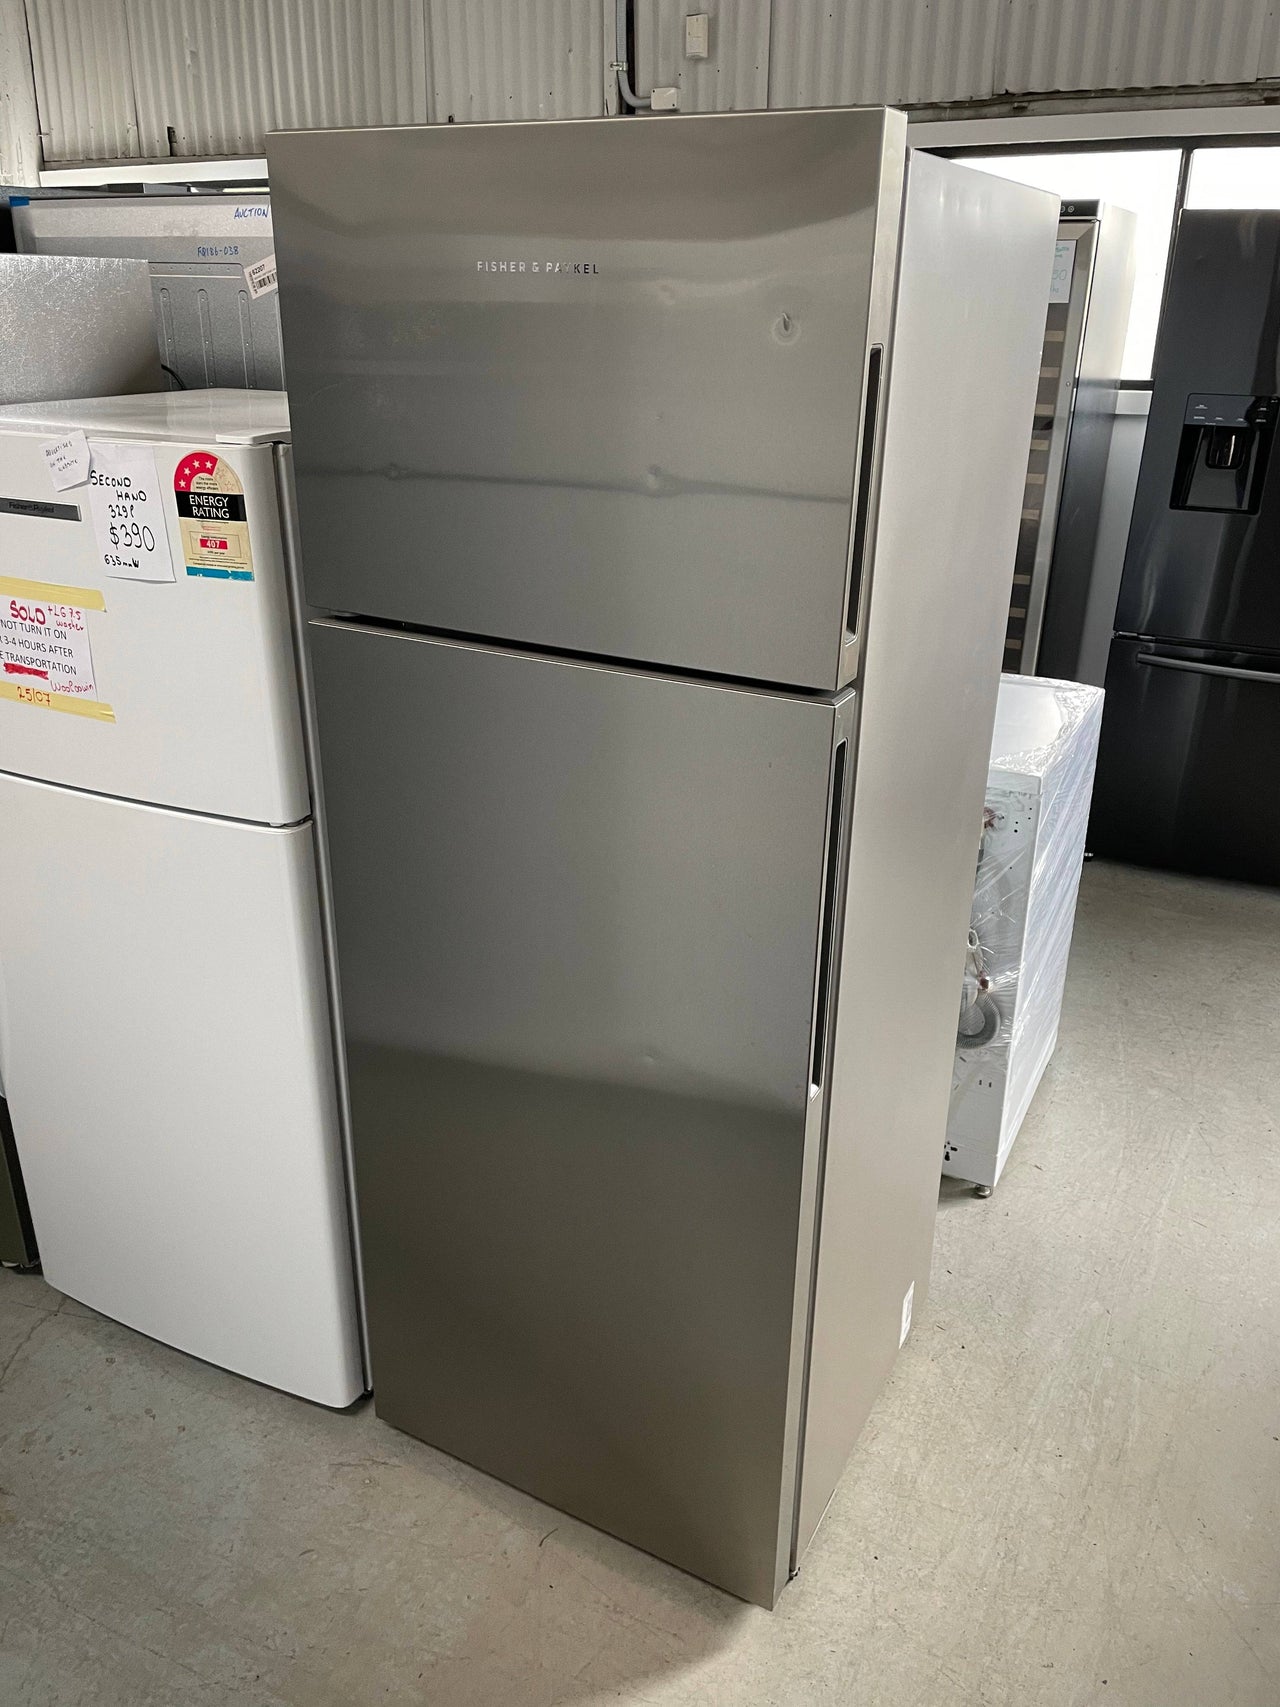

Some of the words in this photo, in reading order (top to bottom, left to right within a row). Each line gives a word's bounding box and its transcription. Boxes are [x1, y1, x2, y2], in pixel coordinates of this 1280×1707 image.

[234, 204, 270, 219] AUCTION
[477, 261, 526, 272] FISHER
[546, 262, 599, 274] PAYKEL
[90, 469, 131, 487] SECOND
[116, 490, 147, 502] HAND
[189, 494, 229, 507] ENERGY
[192, 506, 230, 519] RATING
[109, 521, 156, 552] $390
[206, 540, 220, 549] 407
[9, 599, 46, 625] SOLD
[0, 619, 18, 631] NOT
[19, 622, 42, 636] TURN
[44, 627, 52, 637] IT
[54, 629, 67, 640] ON
[4, 635, 17, 646] 3-4
[18, 638, 47, 653] HOURS
[48, 645, 74, 658] AFTER
[5, 651, 77, 676] TRANSPORTATION
